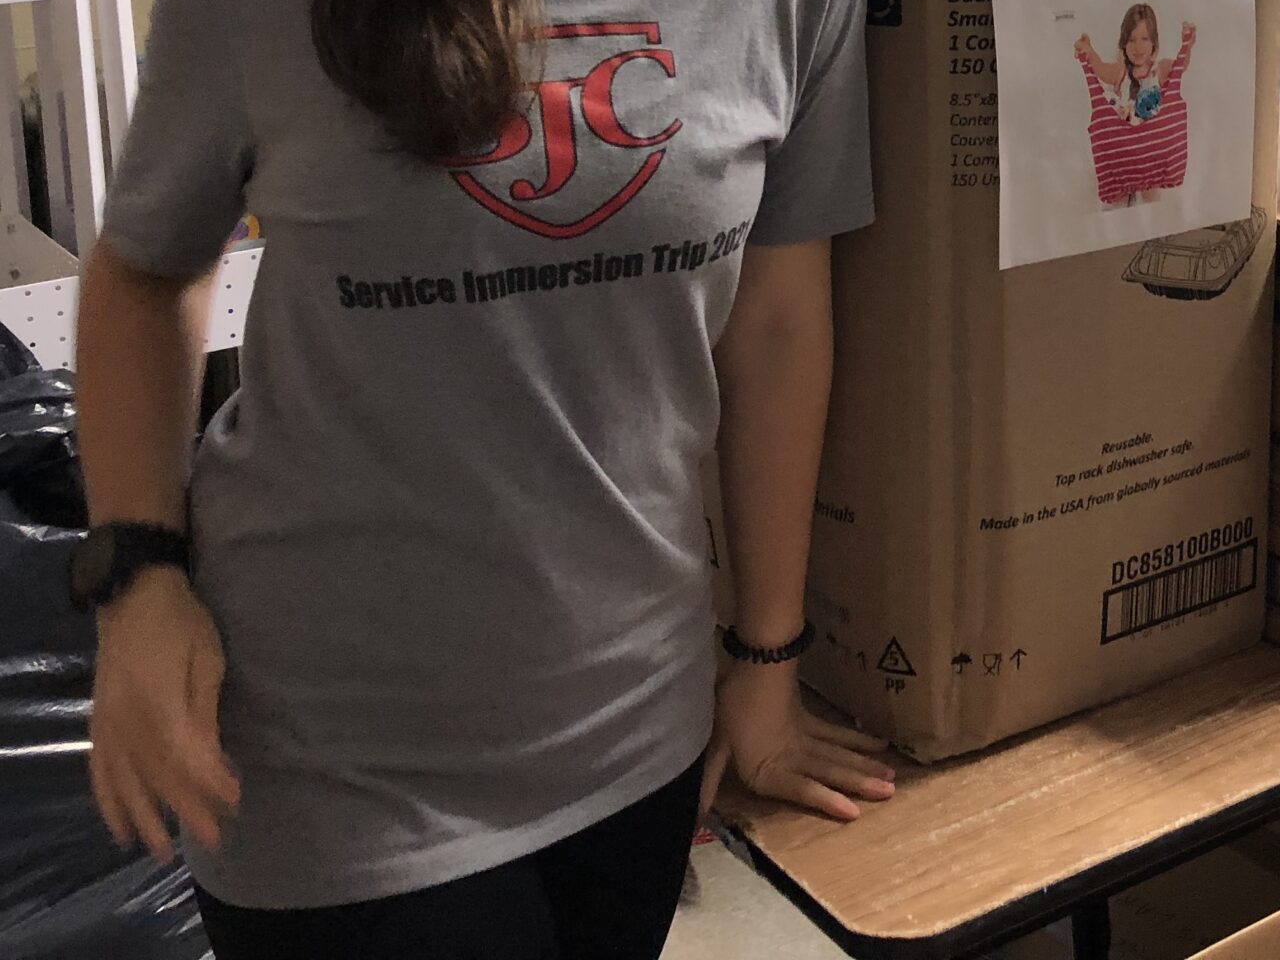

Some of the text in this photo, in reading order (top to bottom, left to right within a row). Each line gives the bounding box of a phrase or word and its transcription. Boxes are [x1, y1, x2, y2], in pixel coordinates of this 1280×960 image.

[949, 35, 959, 51] 1
[949, 58, 985, 75] 150
[950, 154, 958, 167] 1
[951, 174, 978, 187] 150
[336, 273, 457, 310] Service
[462, 247, 644, 304] Immersion
[652, 239, 706, 275] Trip
[1101, 432, 1154, 455] Reusable.
[1055, 473, 1076, 488] Top
[1078, 464, 1103, 481] rack
[1106, 447, 1168, 475] dishwasher
[979, 447, 1251, 531] Made in the USA from globally sourced materials
[1111, 515, 1253, 586] DC858100B000
